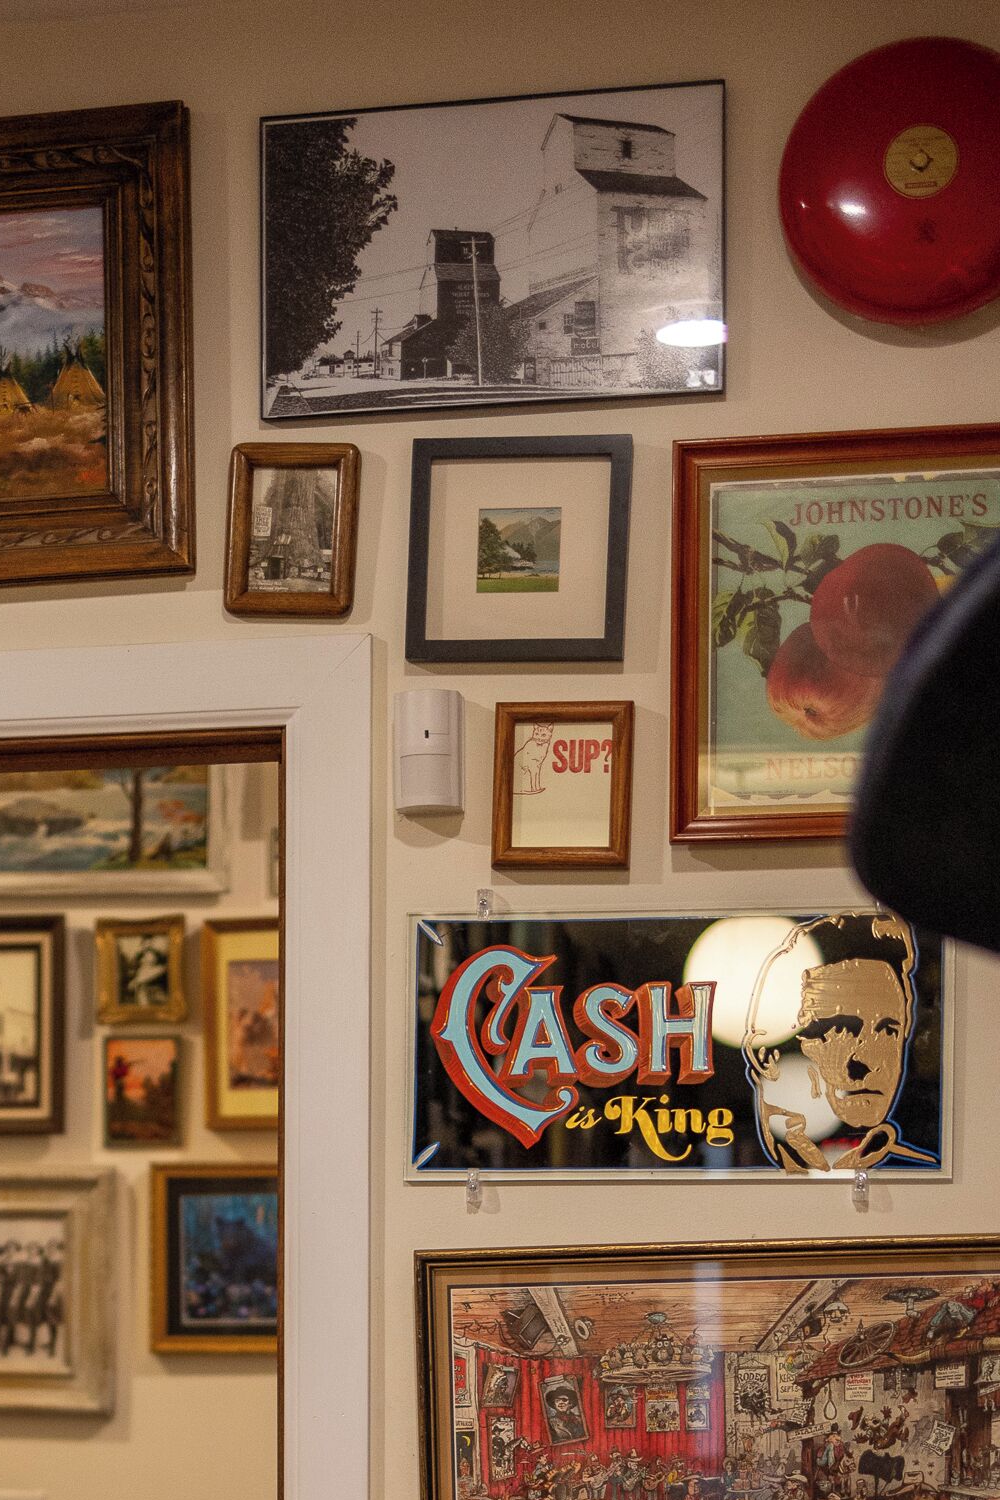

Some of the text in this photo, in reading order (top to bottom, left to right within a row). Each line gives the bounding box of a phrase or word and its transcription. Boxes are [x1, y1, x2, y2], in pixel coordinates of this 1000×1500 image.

[789, 493, 988, 527] JOHNSTONE'S
[551, 738, 613, 774] SUP?
[764, 755, 858, 783] NELSO
[430, 944, 718, 1149] CASH
[565, 1094, 735, 1161] is King
[738, 1371, 768, 1383] RODEO
